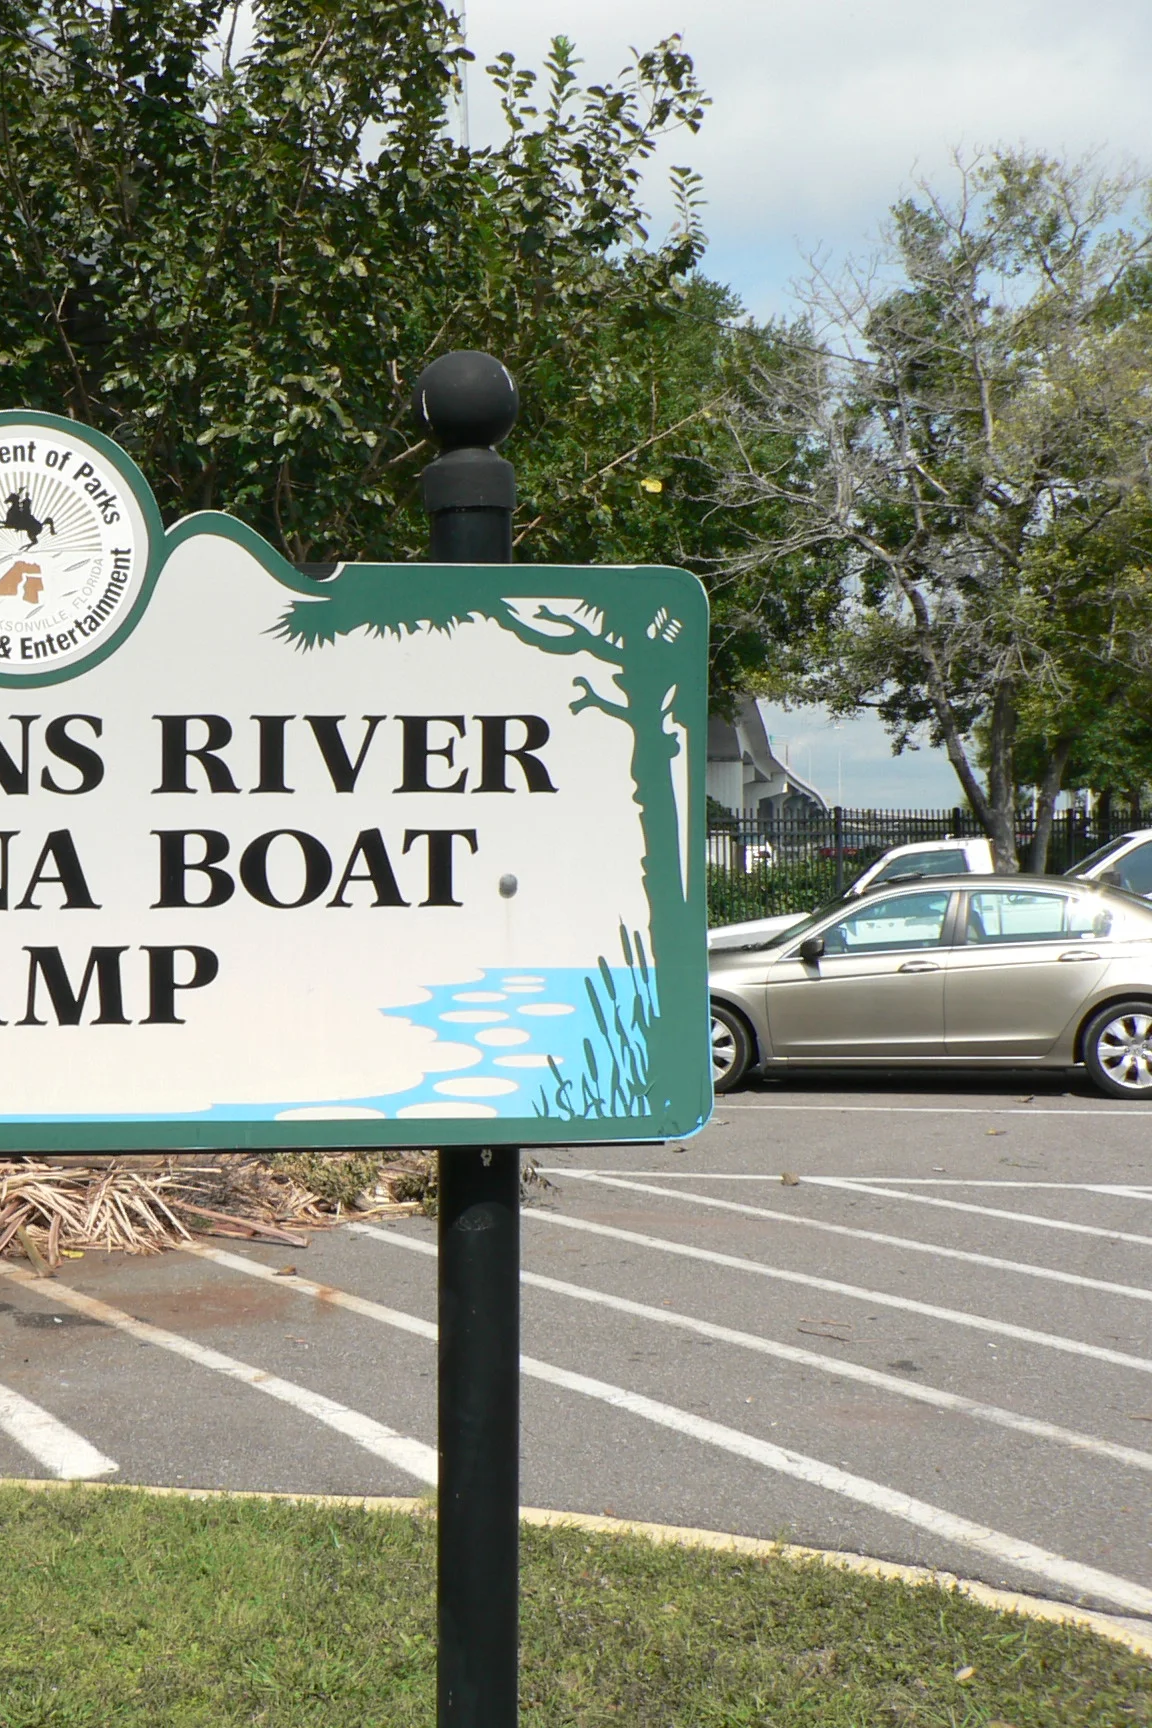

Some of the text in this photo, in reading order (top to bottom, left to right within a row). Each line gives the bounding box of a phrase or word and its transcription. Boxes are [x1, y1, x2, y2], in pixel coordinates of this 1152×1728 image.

[44, 449, 73, 471] of
[73, 462, 120, 525] Parks
[20, 547, 132, 660] Entertainment
[72, 558, 105, 611] FLORIDA
[151, 713, 559, 795] RIVER
[149, 827, 479, 910] BOAT
